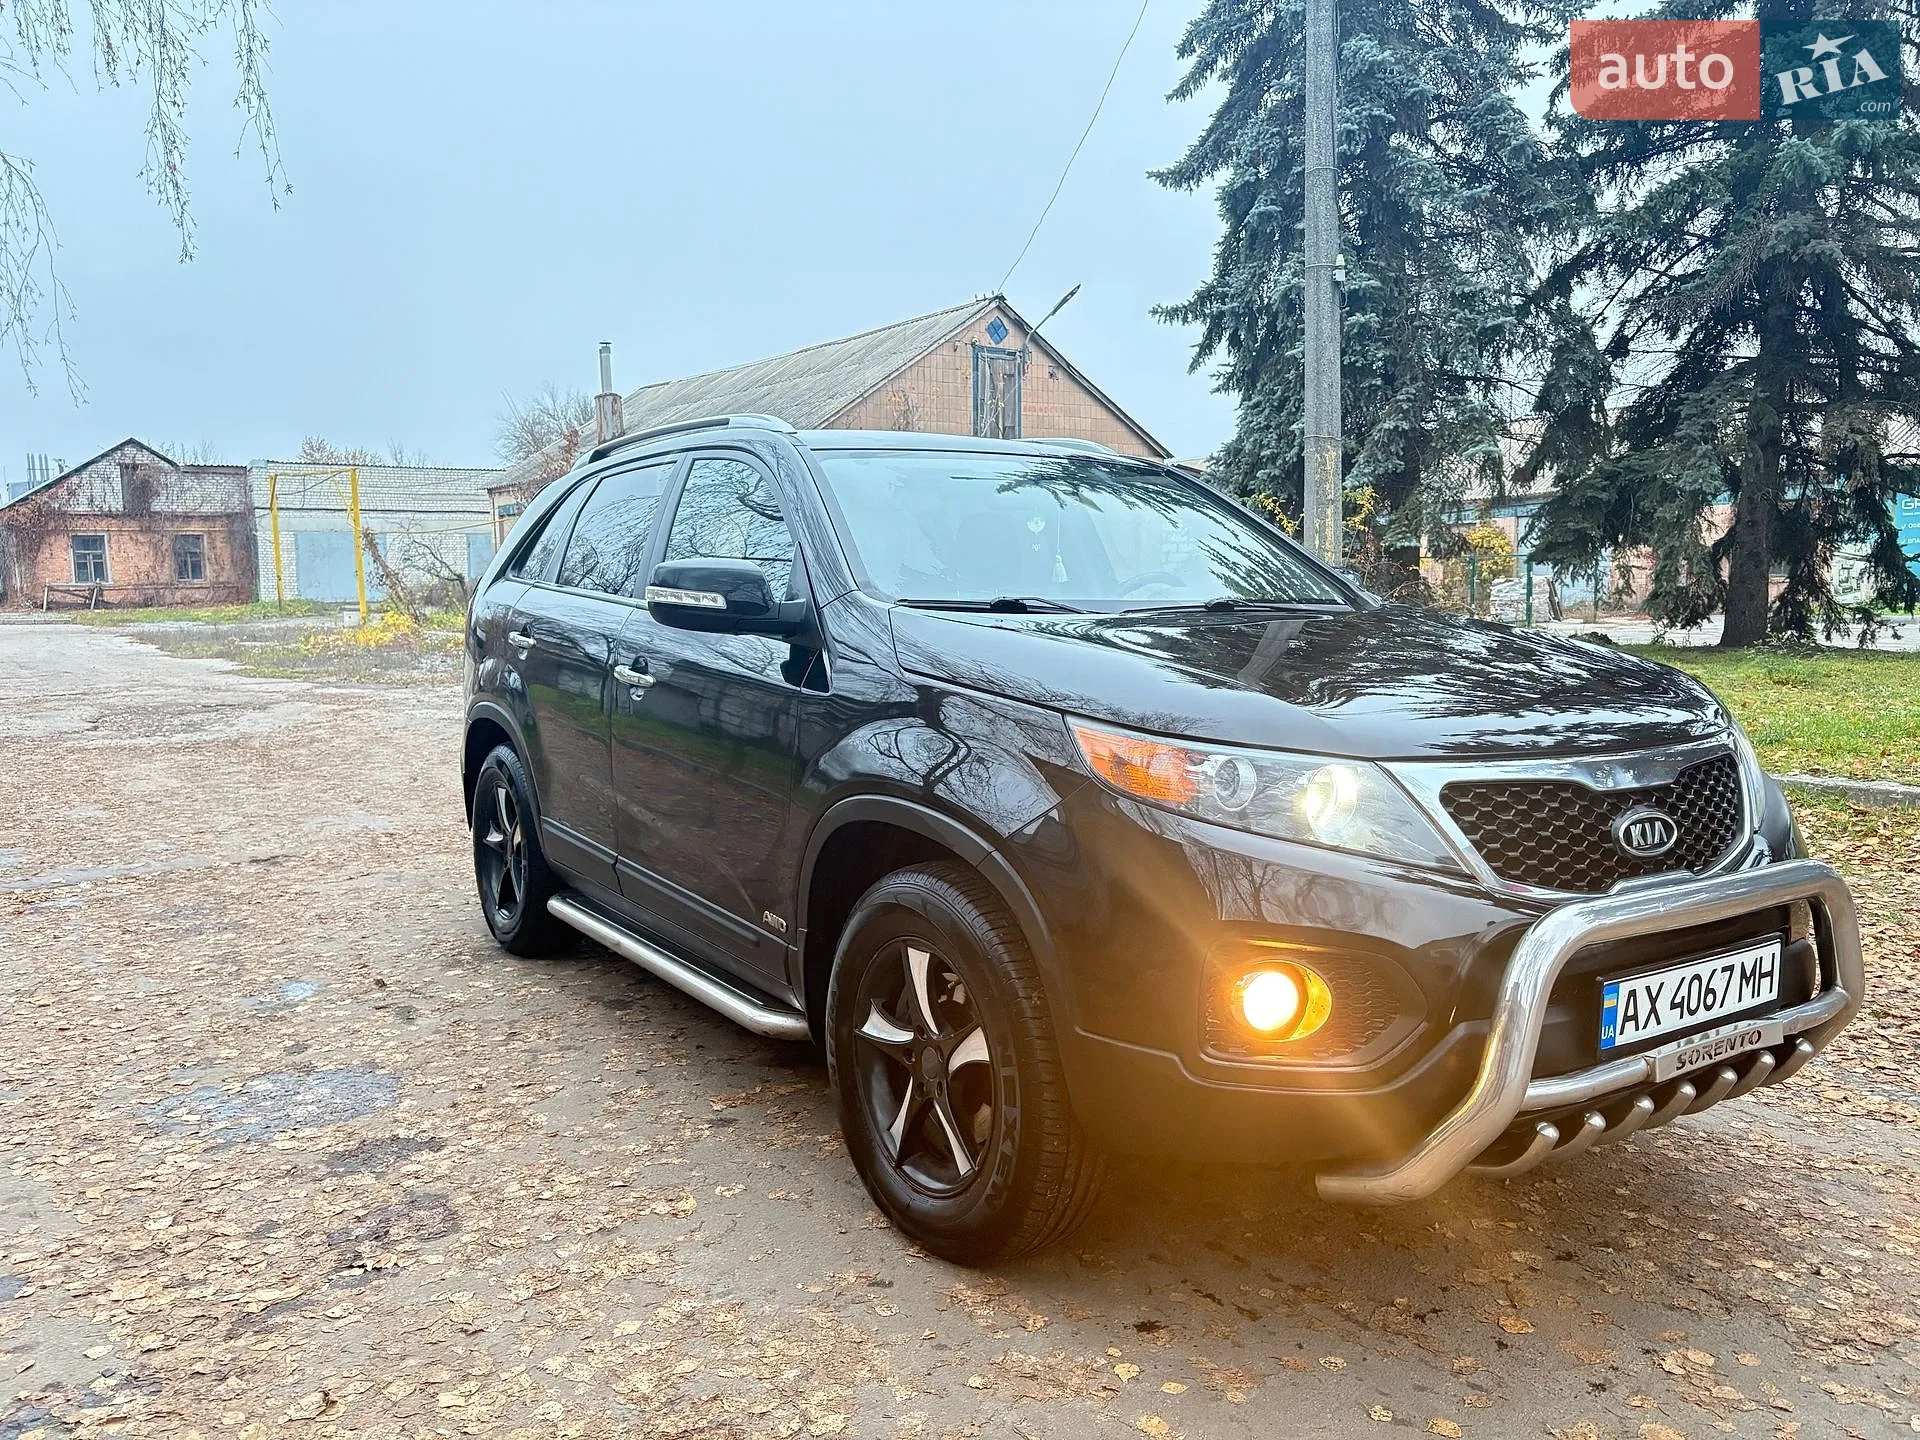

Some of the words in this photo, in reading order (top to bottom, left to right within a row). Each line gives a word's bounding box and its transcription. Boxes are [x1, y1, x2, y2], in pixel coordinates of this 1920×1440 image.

[1629, 820, 1668, 848] KIA
[1619, 981, 1665, 1037] AX
[1669, 963, 1735, 1020] 4067
[1737, 952, 1775, 1004] MH
[1601, 1024, 1615, 1040] UA
[1675, 1029, 1762, 1071] SORENTO
